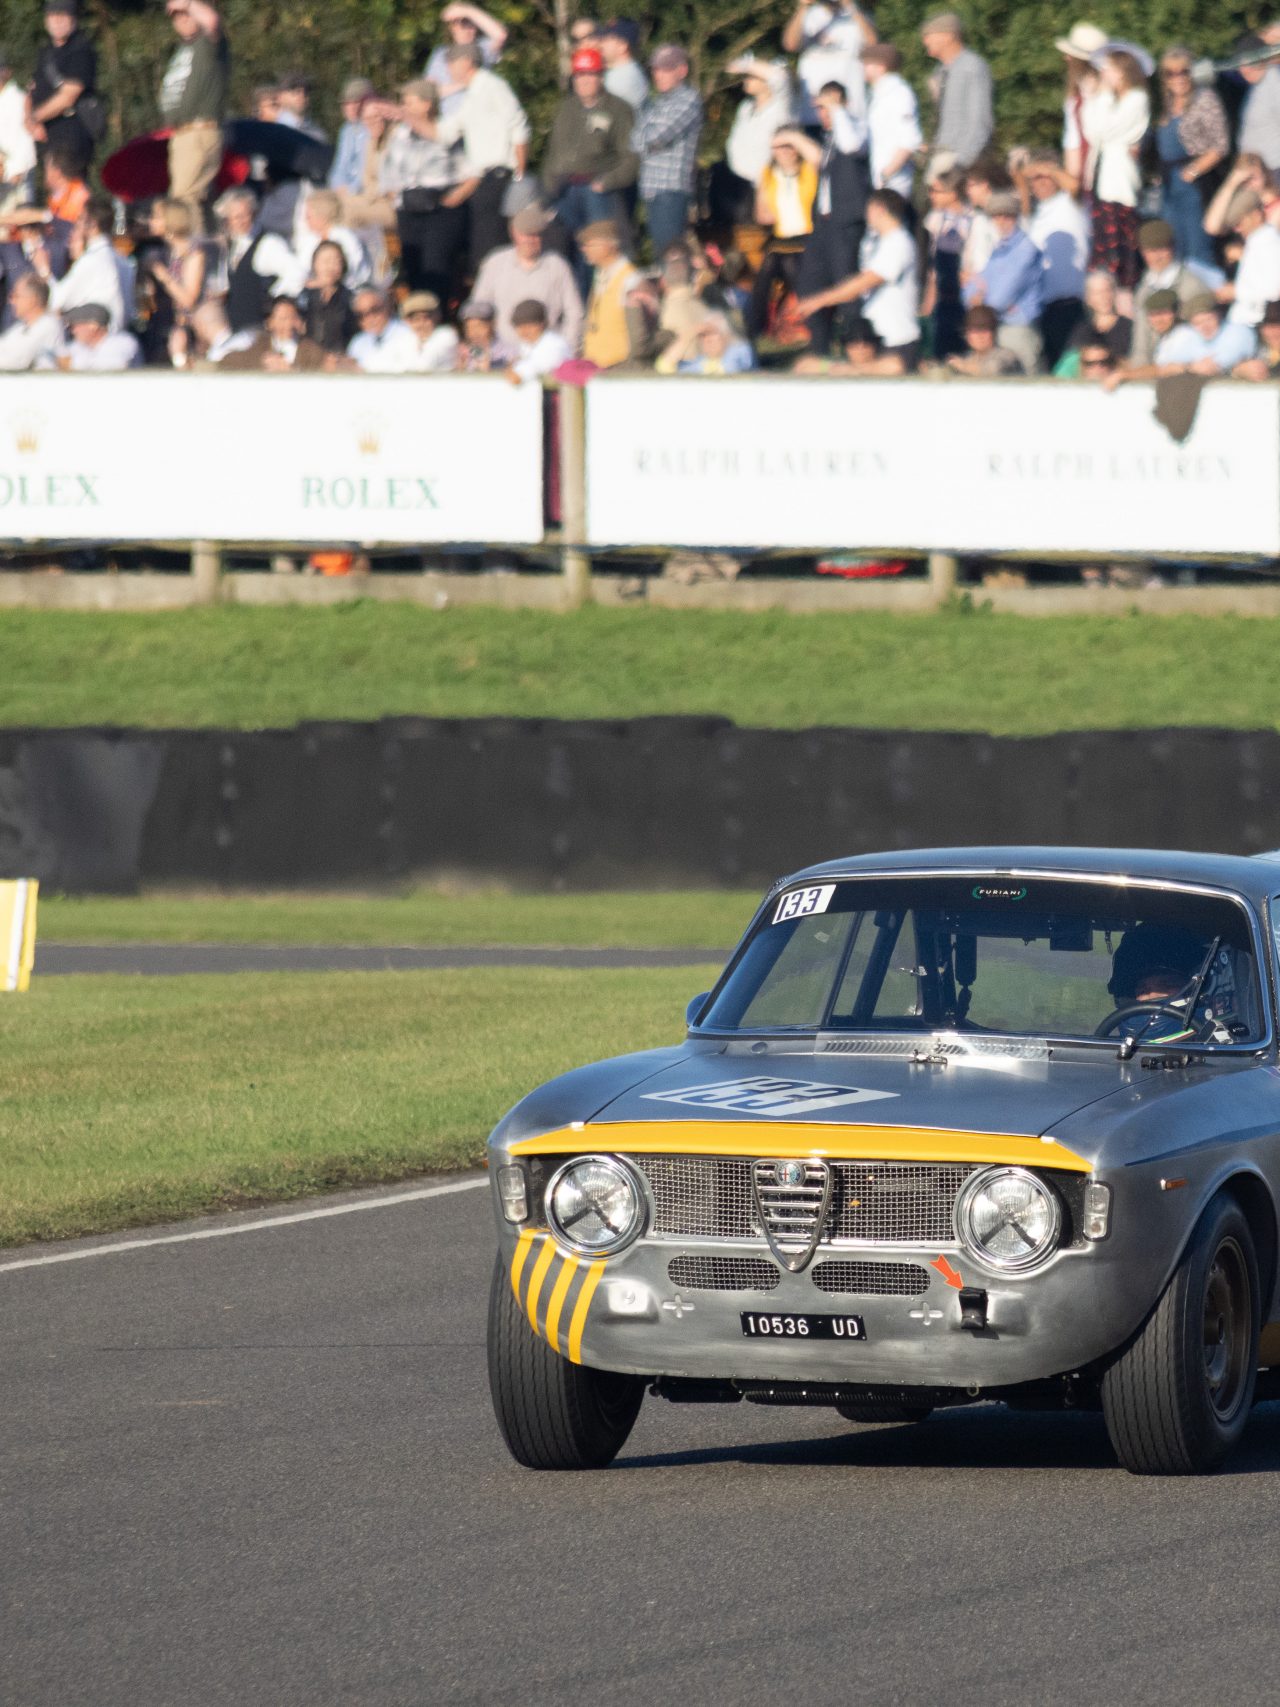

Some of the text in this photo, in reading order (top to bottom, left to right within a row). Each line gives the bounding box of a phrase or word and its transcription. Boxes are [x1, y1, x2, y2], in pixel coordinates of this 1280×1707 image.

[632, 447, 891, 480] RALPH LAUREN
[985, 450, 1233, 481] RALPH LAUREN
[301, 475, 441, 510] ROLEX
[776, 888, 823, 921] 133
[657, 1078, 858, 1110] 133
[747, 1315, 860, 1336] 10536 UD
